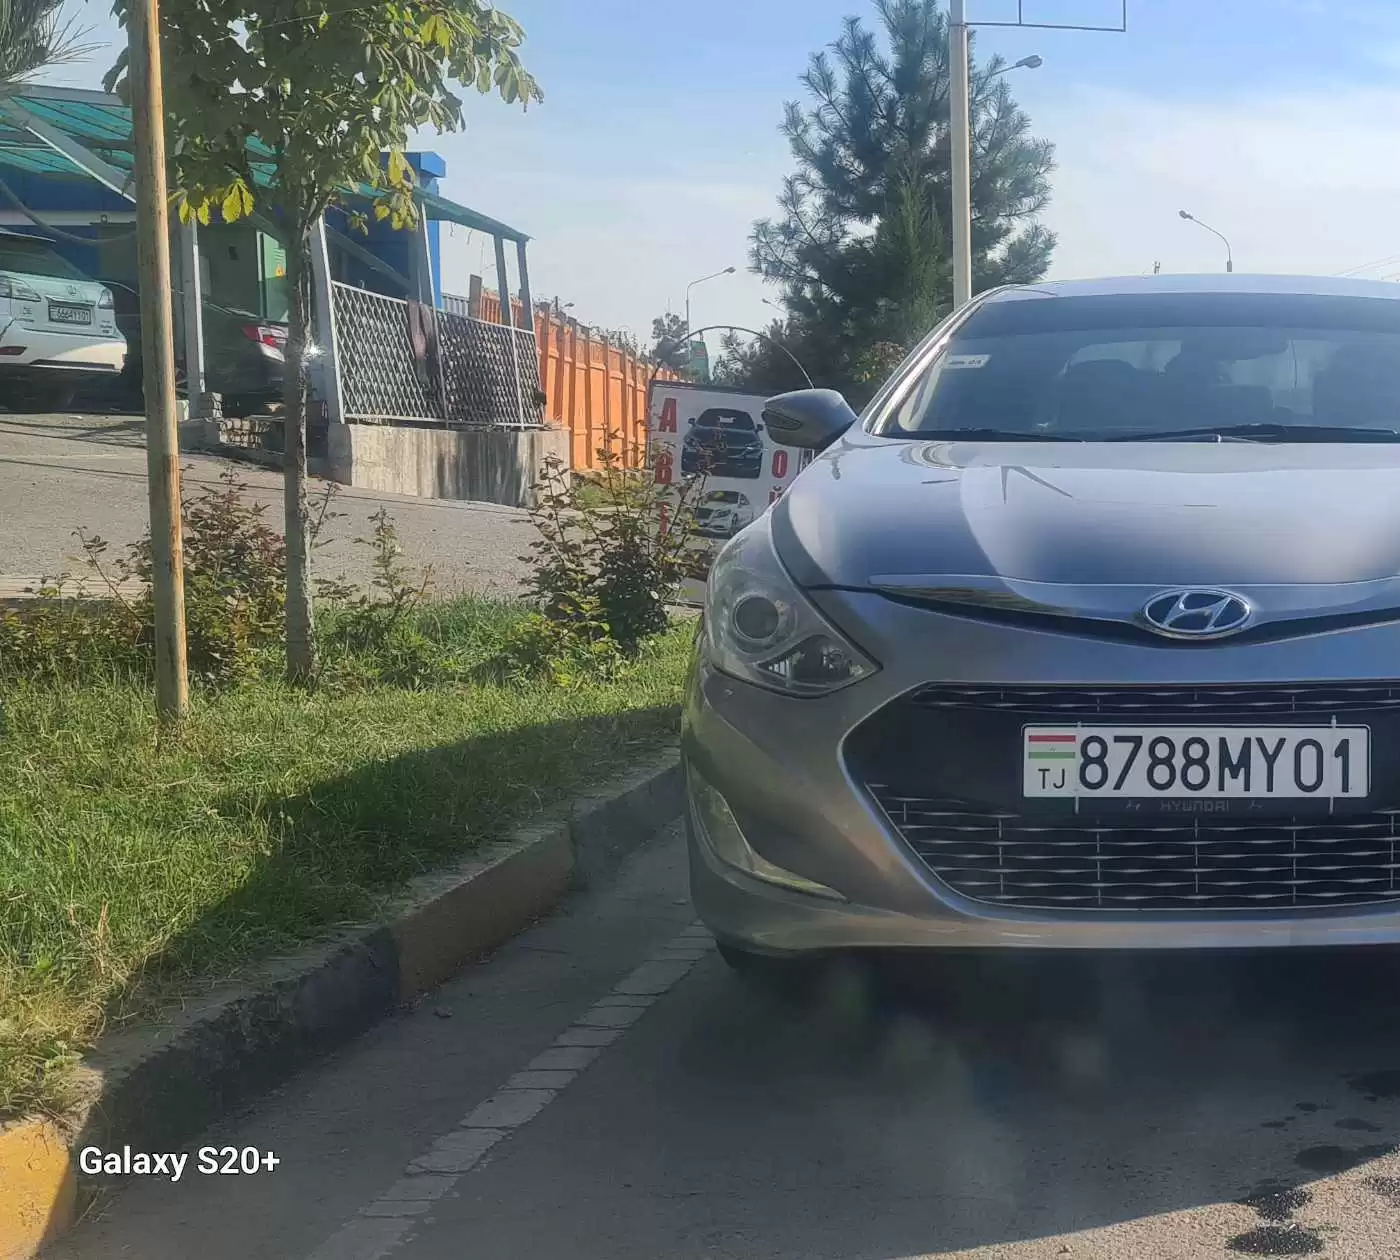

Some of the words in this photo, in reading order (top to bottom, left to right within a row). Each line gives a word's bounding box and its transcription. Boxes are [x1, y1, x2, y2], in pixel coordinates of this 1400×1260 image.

[1079, 735, 1352, 793] 8788MY01
[1038, 768, 1066, 789] TJ
[1160, 800, 1231, 813] HYUNDAI
